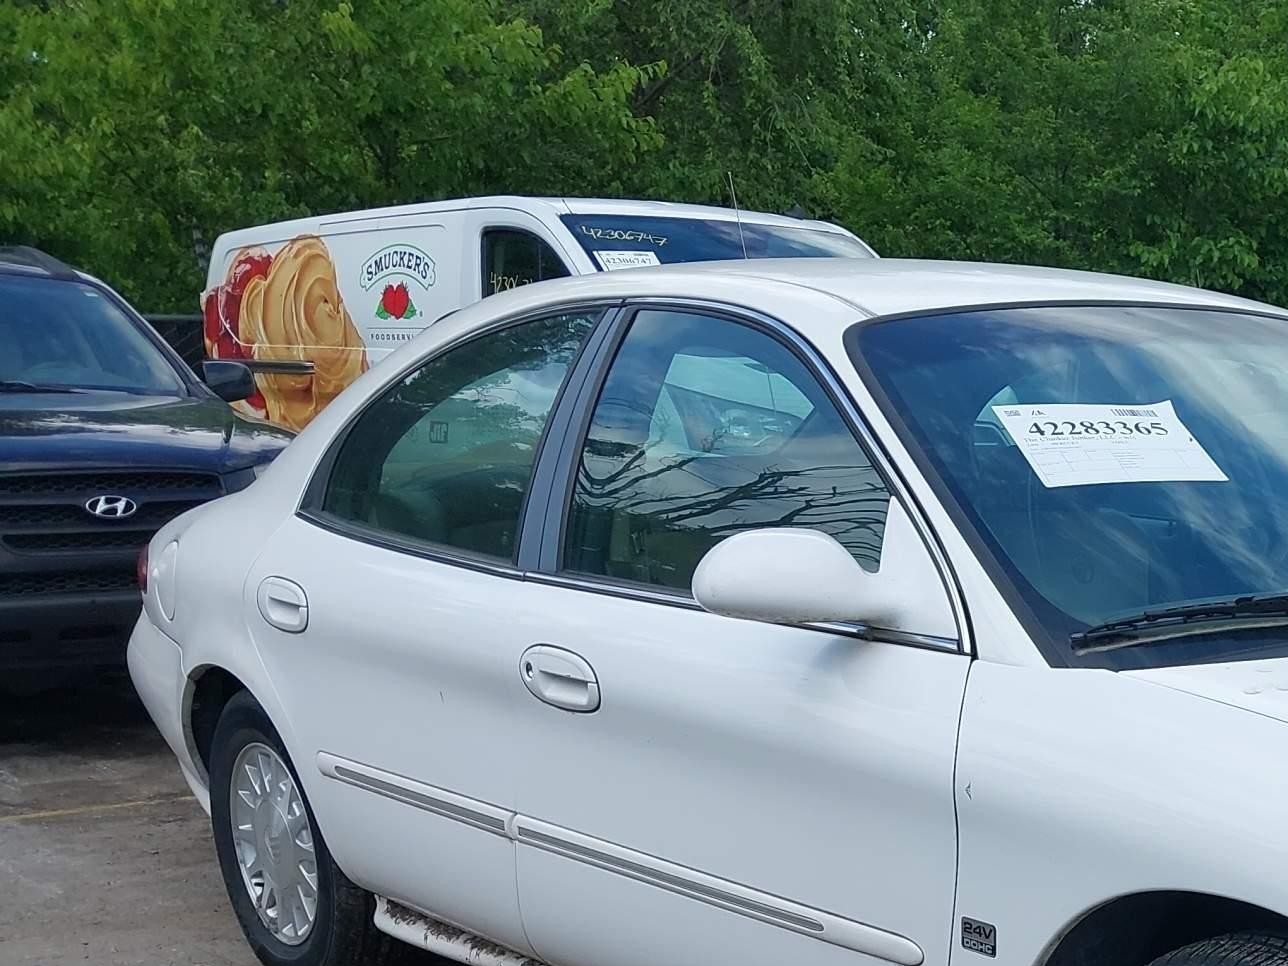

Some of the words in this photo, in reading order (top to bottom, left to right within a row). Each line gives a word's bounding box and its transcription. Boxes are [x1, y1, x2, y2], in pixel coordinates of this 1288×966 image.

[581, 225, 668, 246] 42306747
[366, 250, 430, 282] SMUCKER'S
[1028, 420, 1169, 437] 42283365
[963, 921, 993, 939] 24V
[963, 938, 993, 954] DOHC
